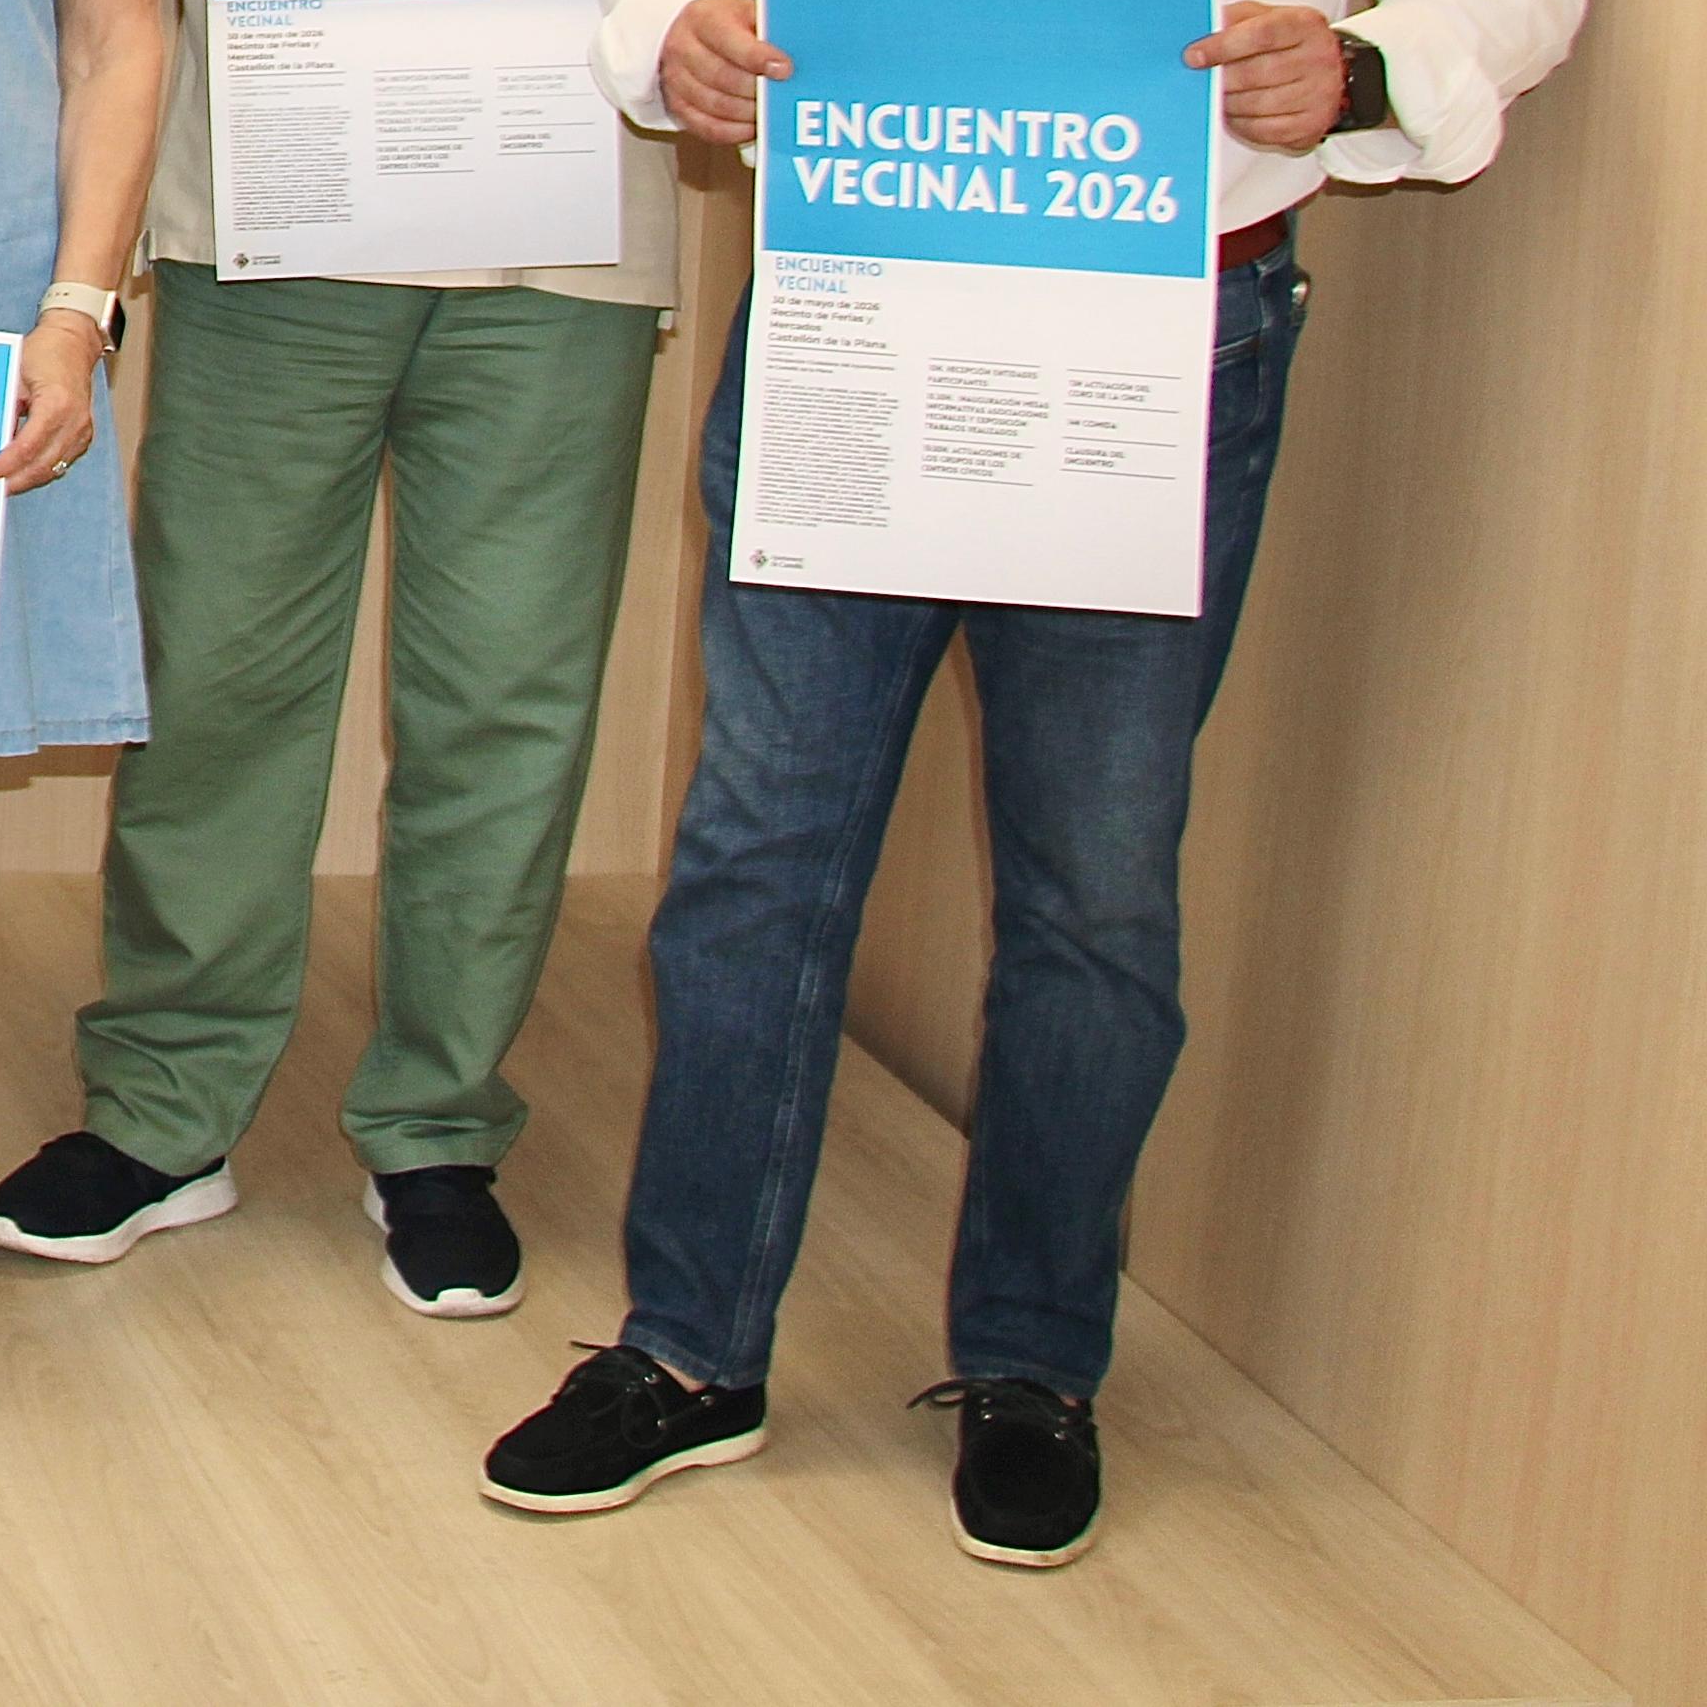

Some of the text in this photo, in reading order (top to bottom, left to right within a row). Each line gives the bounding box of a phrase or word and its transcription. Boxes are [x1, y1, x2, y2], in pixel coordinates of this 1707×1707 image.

[227, 0, 323, 12] ENCUENTRO
[227, 15, 292, 27] VECINAL
[797, 101, 1141, 162] ENCUENTRO
[793, 157, 1179, 223] VECINAL 2026
[777, 256, 882, 277] ENCUENTRO
[776, 276, 848, 294] VECINAL
